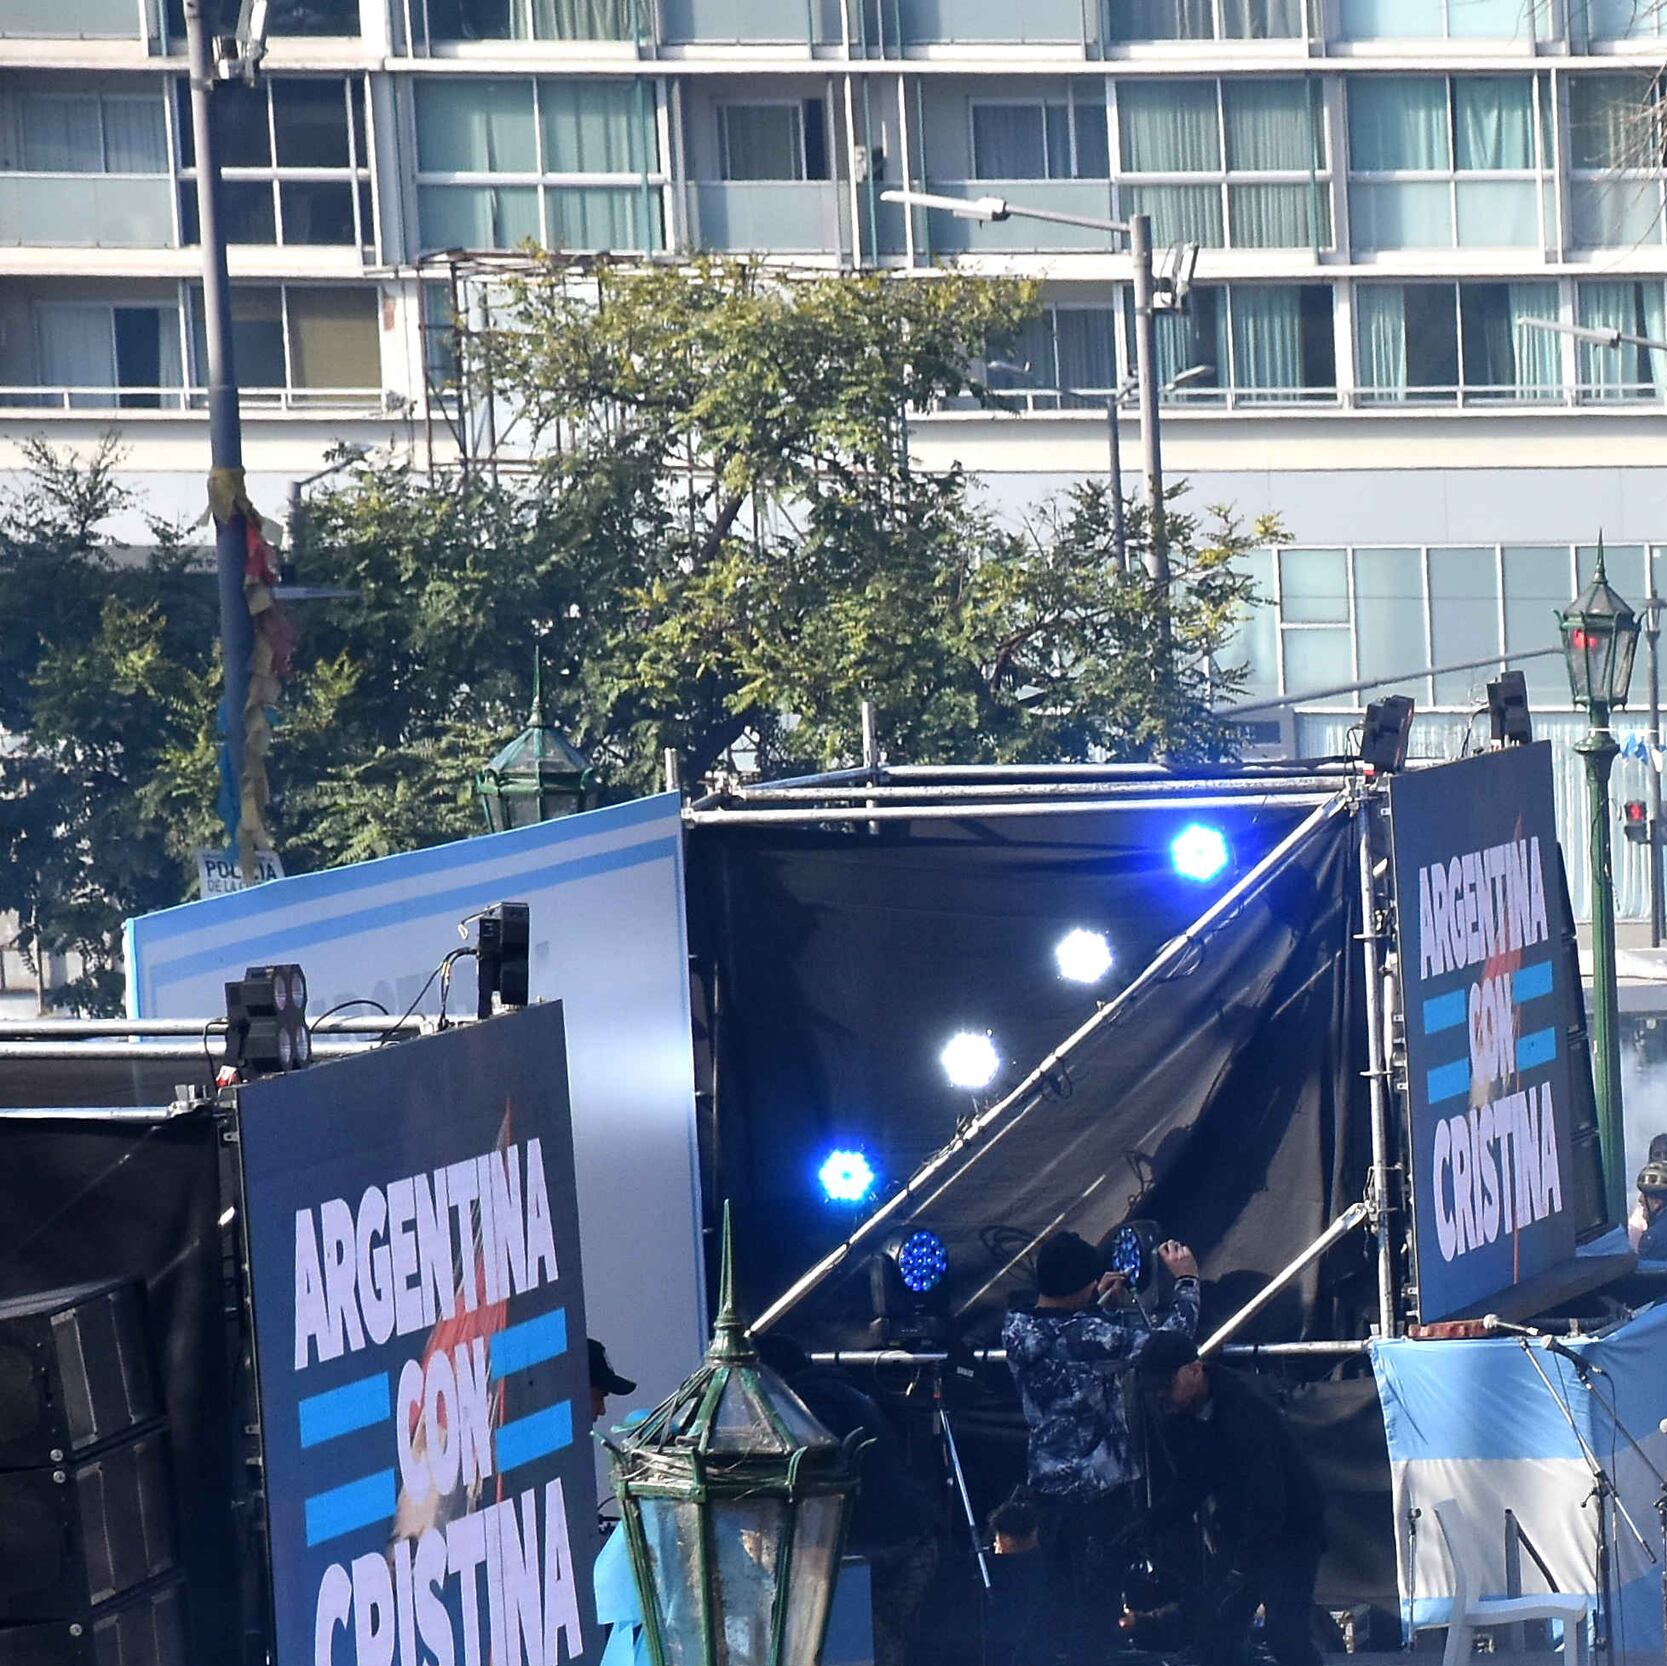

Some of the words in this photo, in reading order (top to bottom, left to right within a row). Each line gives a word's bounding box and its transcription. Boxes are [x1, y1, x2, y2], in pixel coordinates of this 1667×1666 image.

[205, 860, 277, 880] POLIA
[1419, 836, 1549, 980] ARGENTINA
[1468, 972, 1516, 1083] CON
[1433, 1081, 1563, 1262] CRISTINA
[294, 1138, 559, 1371] ARGENTINA
[396, 1336, 493, 1505] CON
